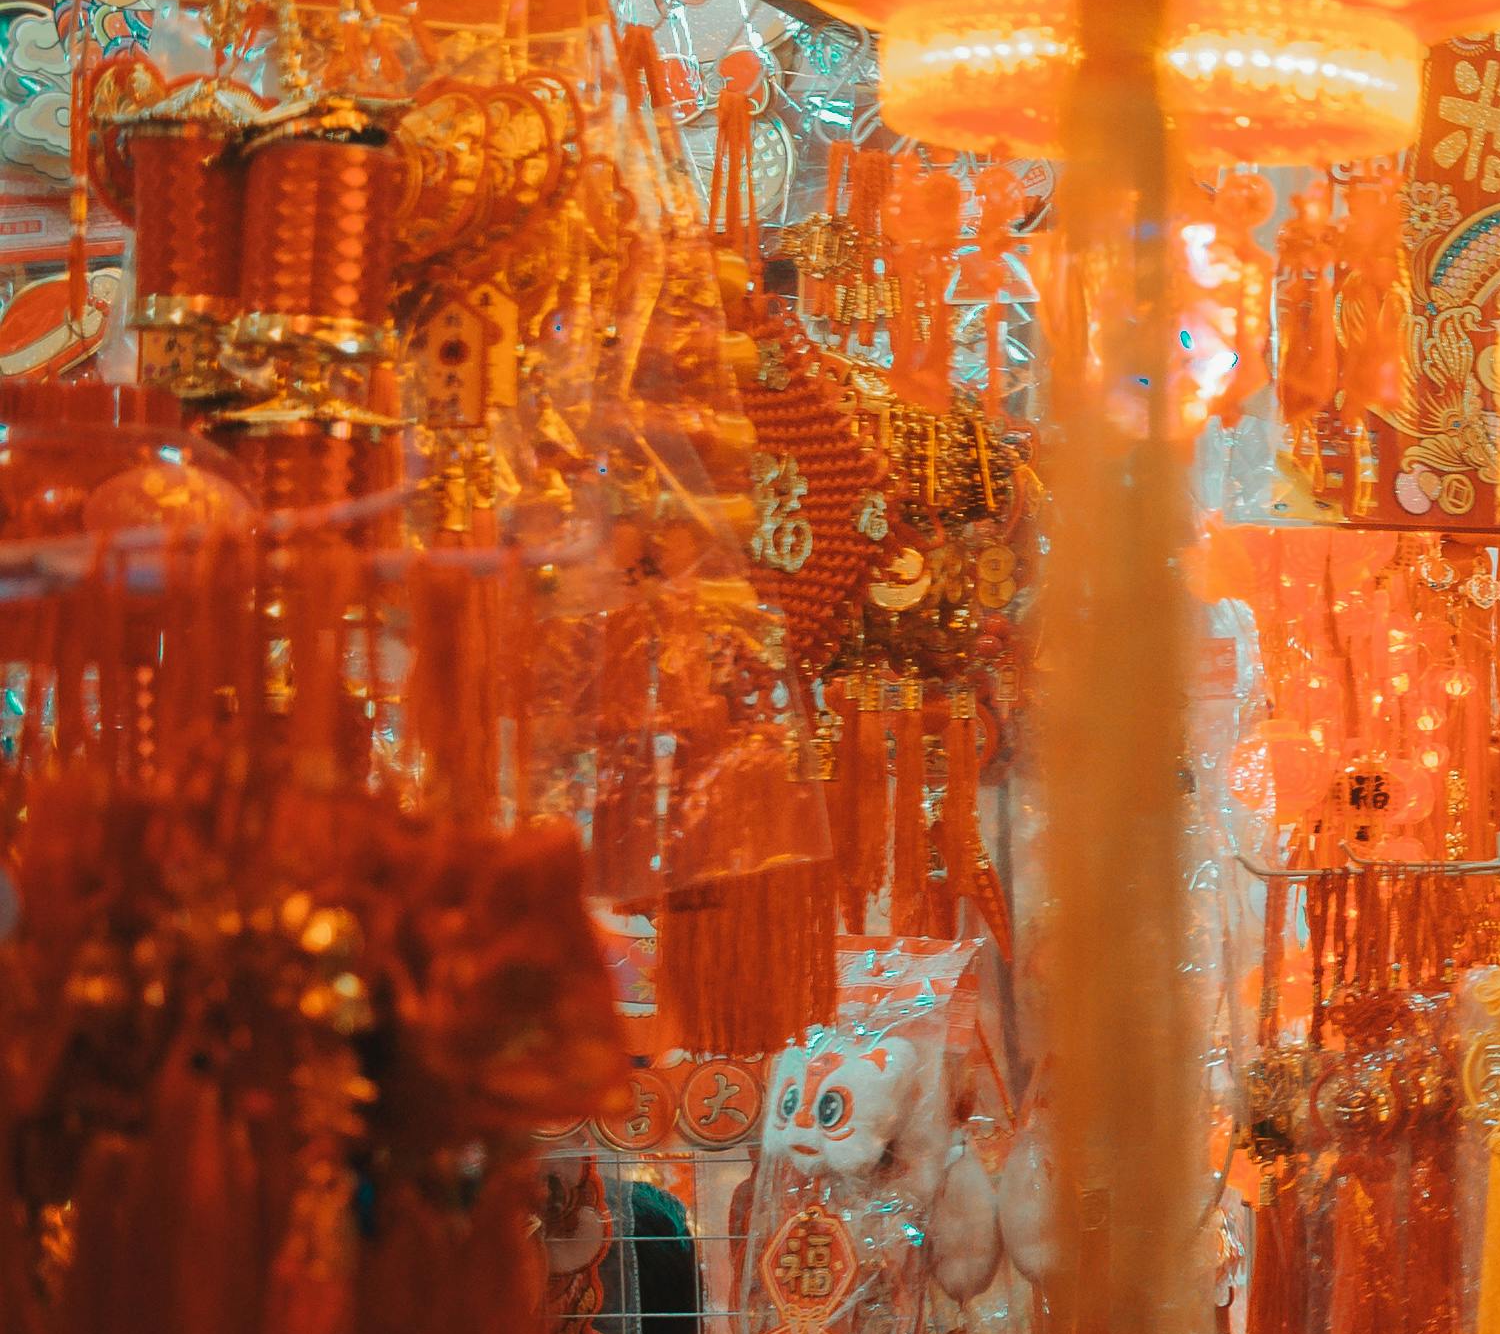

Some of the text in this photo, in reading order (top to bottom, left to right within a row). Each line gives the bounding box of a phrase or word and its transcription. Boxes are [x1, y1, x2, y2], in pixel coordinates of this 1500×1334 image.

[1350, 775, 1391, 810] 福
[700, 1072, 750, 1126] 大
[780, 1234, 833, 1299] 福
